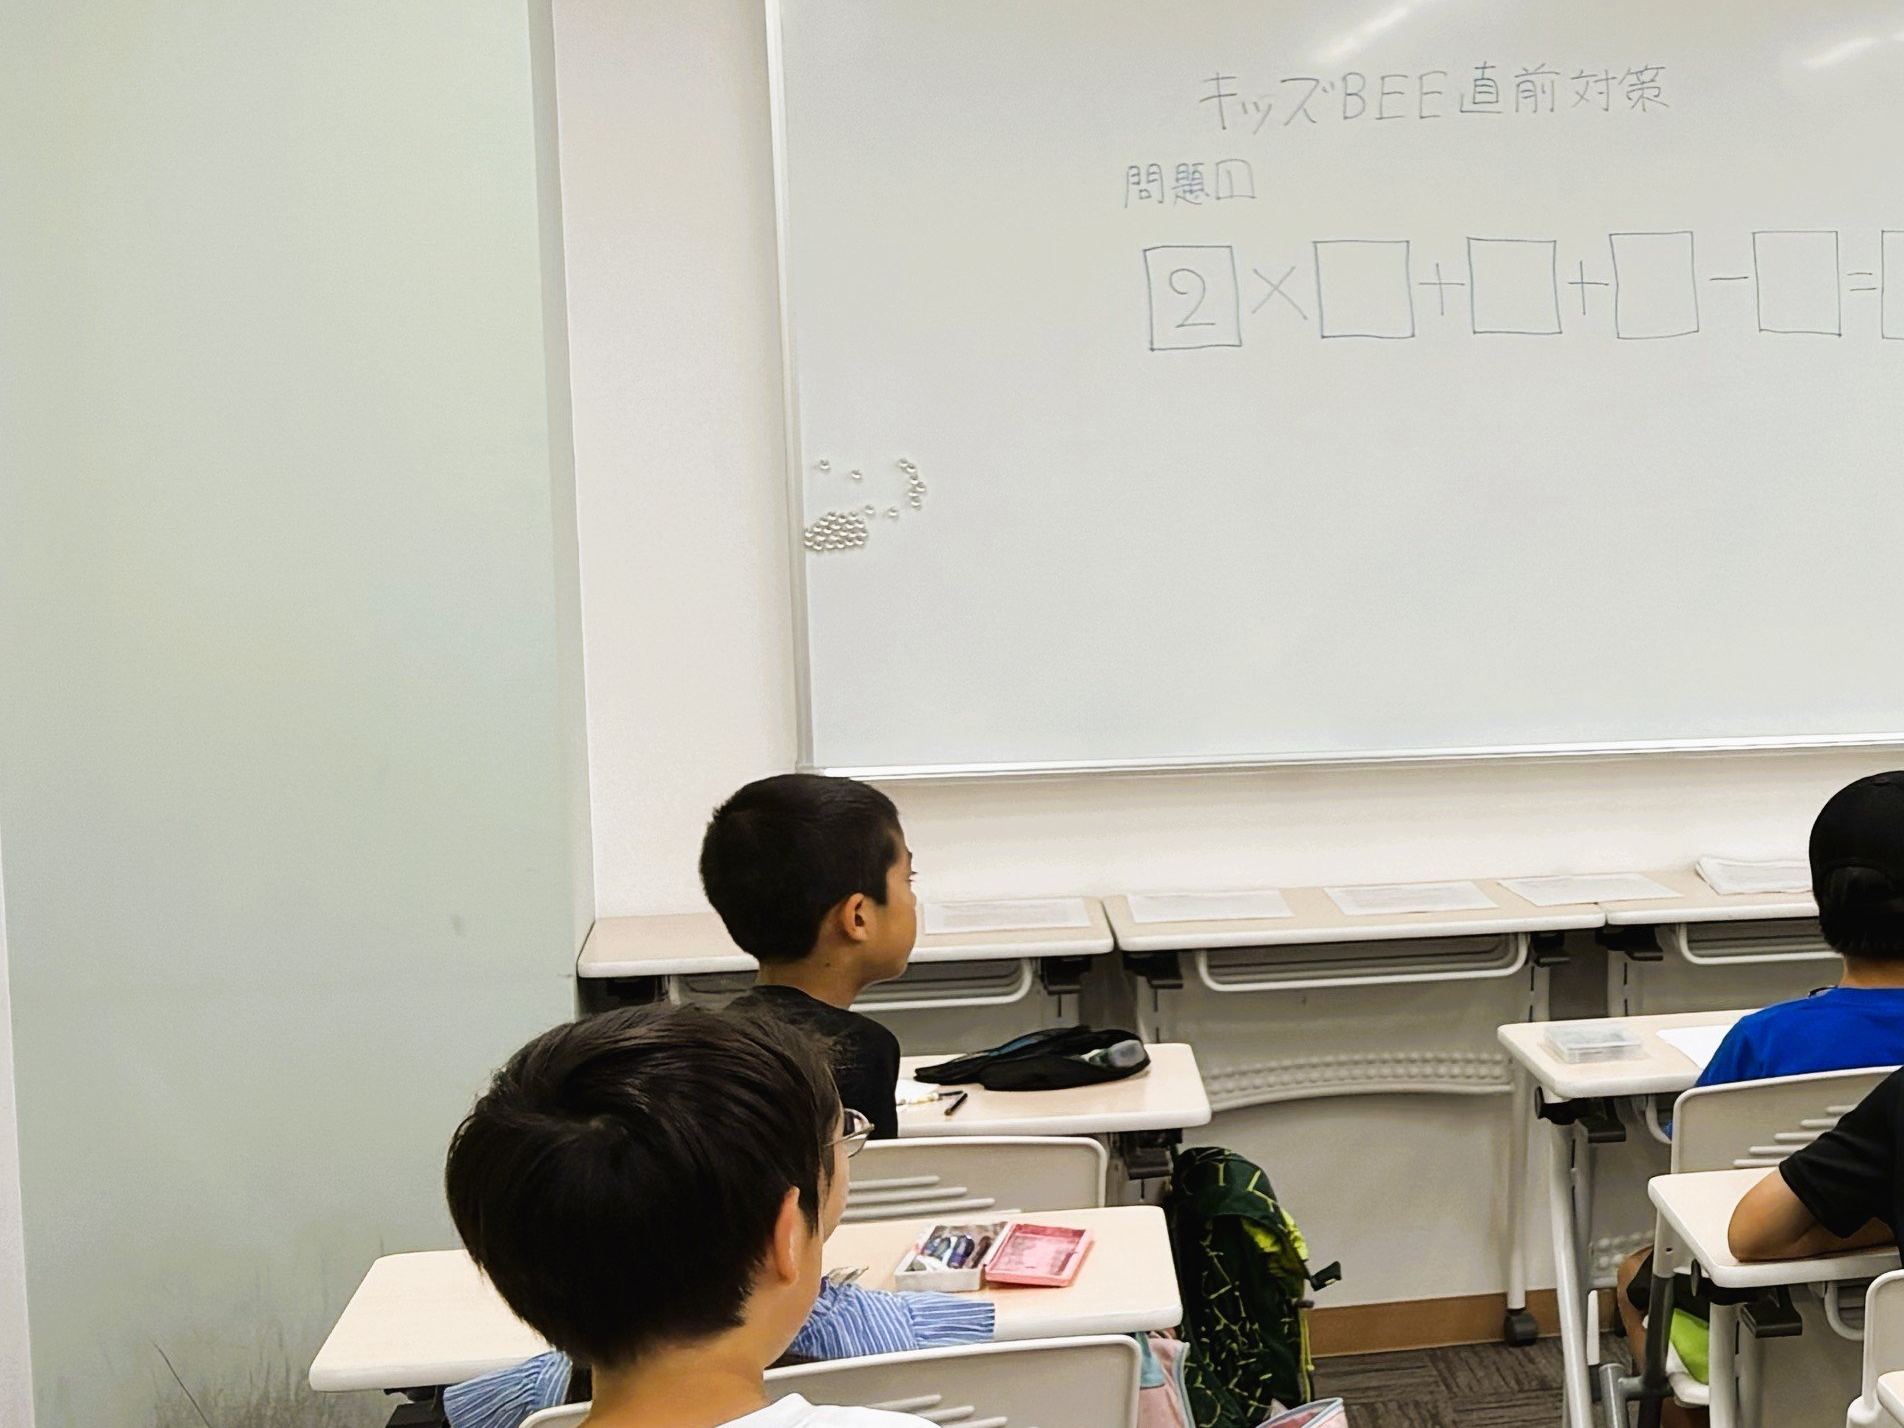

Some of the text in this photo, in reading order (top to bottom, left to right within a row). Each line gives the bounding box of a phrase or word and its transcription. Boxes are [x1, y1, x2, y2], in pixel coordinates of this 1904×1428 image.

[1199, 60, 1670, 135] キッズBEE直前対策
